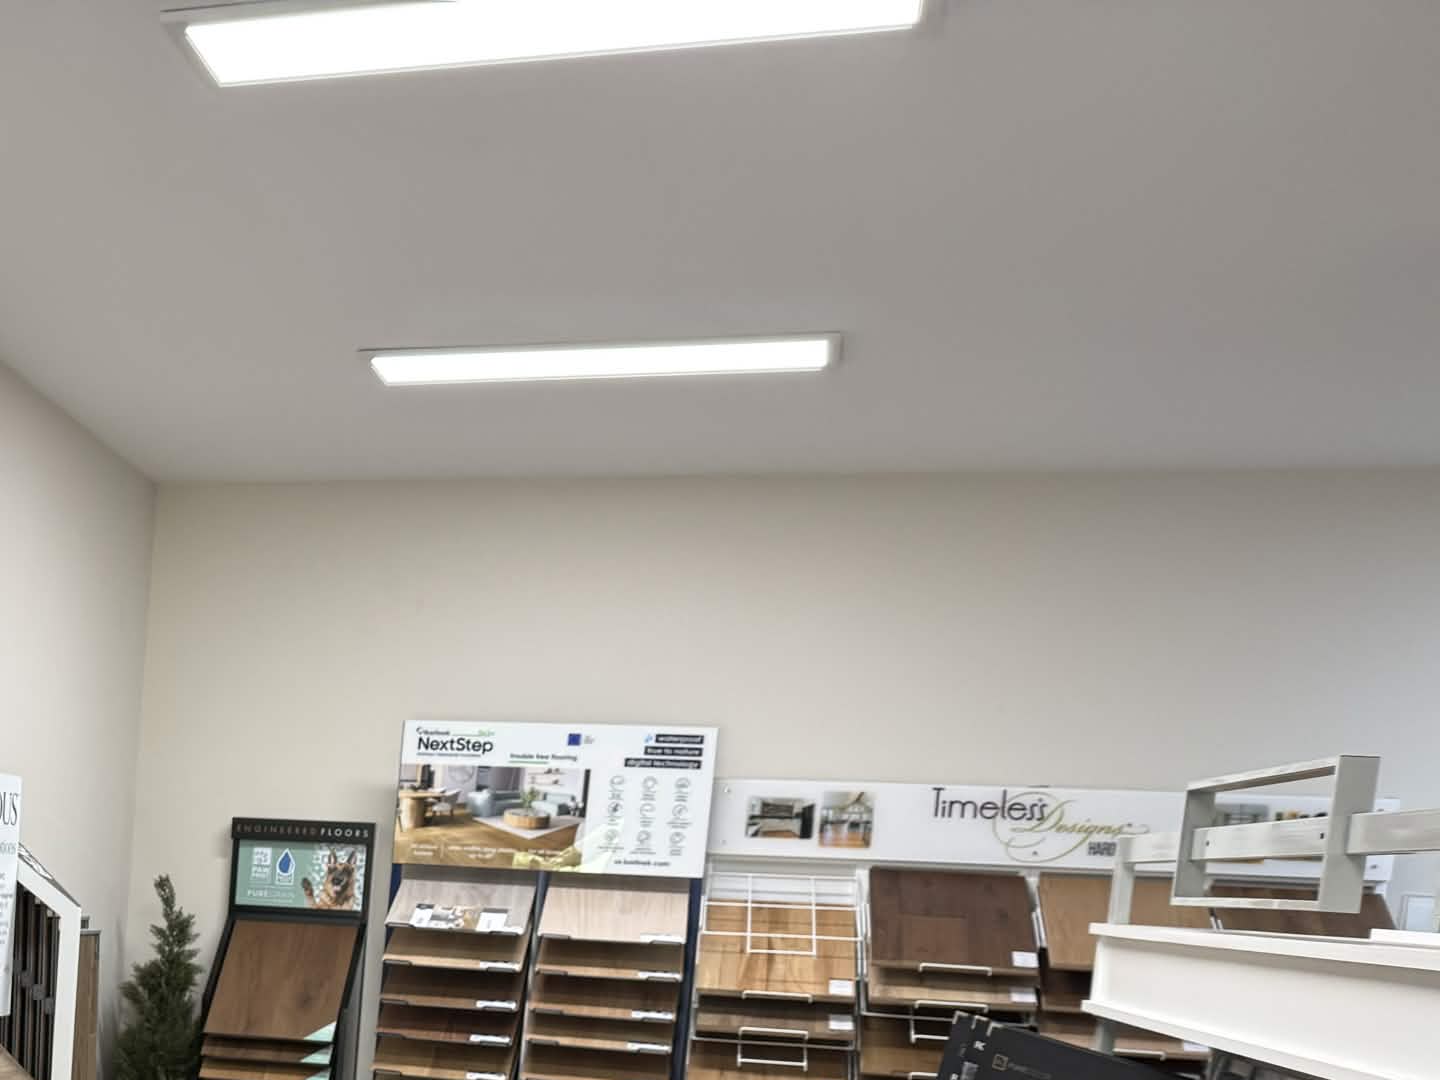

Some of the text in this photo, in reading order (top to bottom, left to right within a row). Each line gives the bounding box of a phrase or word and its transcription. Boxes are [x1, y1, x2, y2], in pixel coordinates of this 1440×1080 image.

[417, 736, 494, 755] NextStep
[932, 787, 1047, 821] Timeless
[236, 823, 370, 838] ENGINEERED FLOORS
